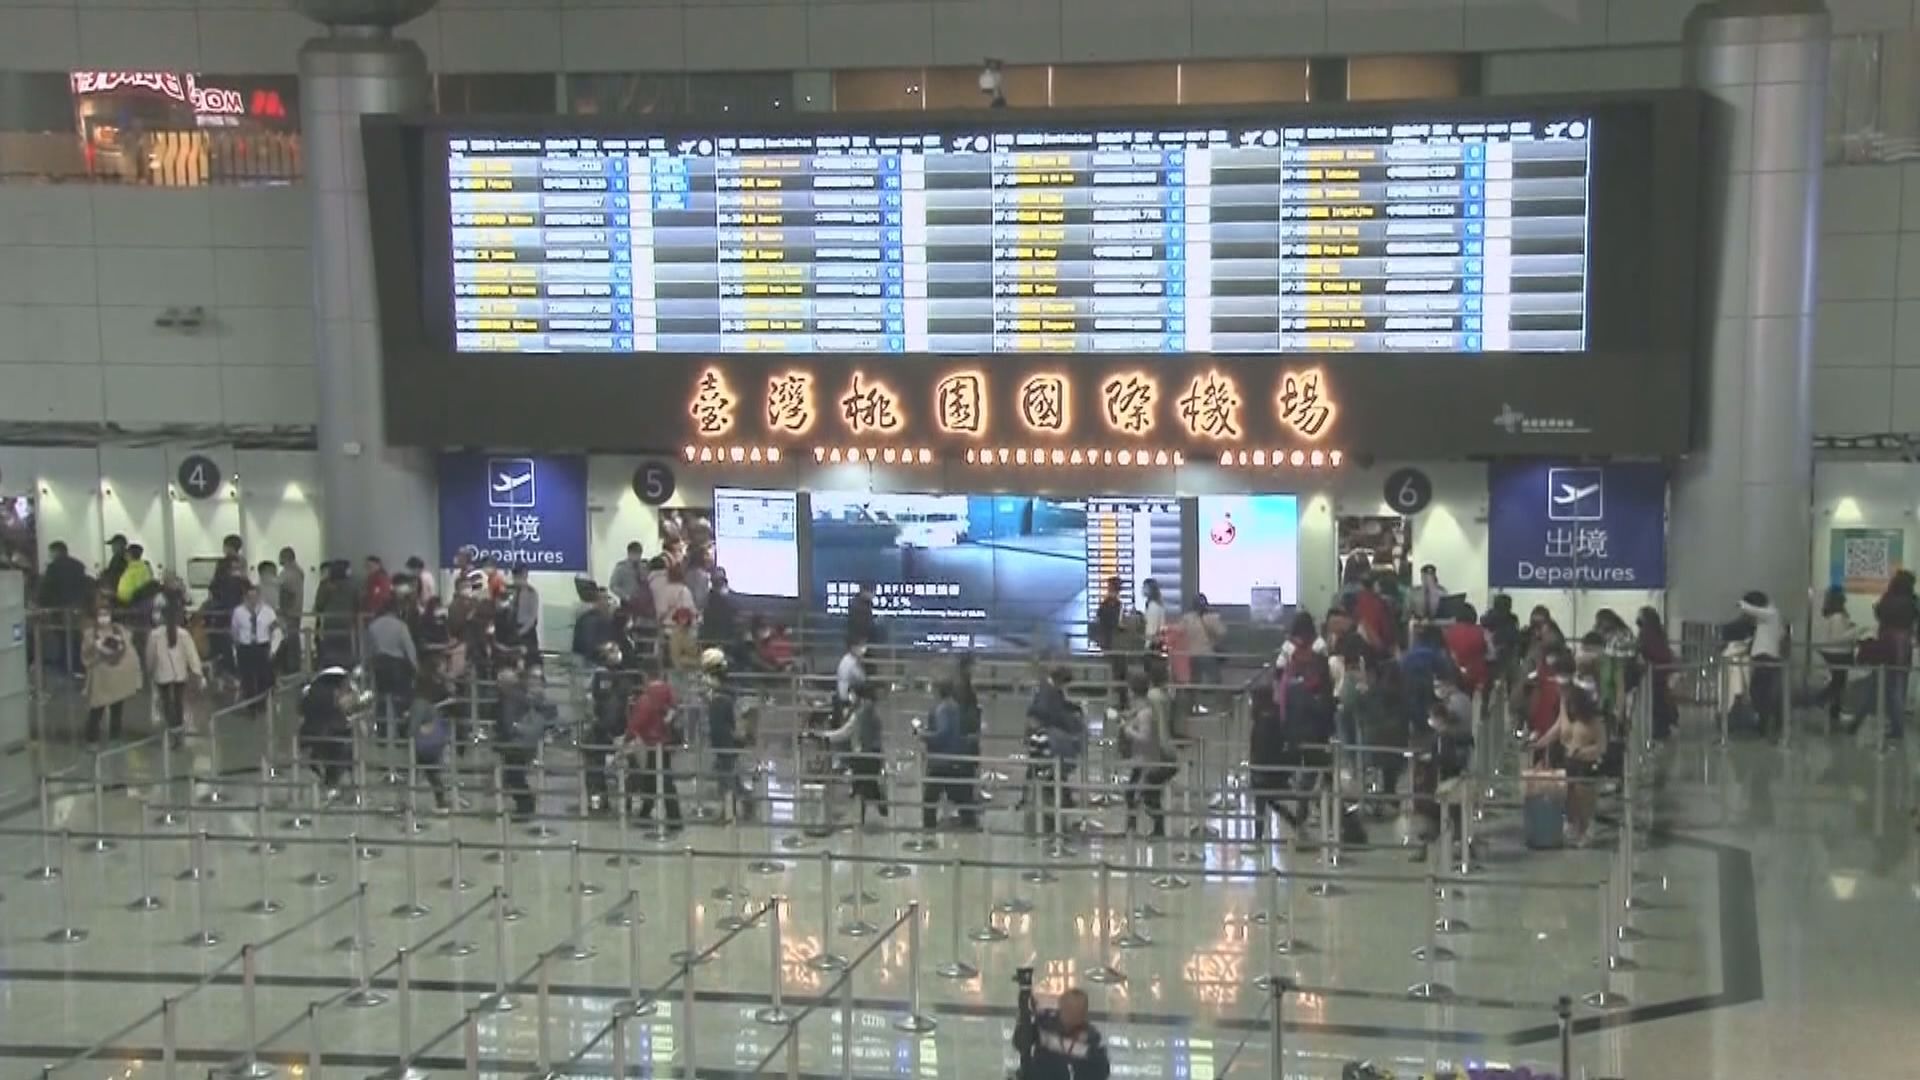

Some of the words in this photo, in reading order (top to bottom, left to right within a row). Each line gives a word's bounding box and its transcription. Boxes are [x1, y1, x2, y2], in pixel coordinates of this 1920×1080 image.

[690, 369, 1336, 439] 臺灣桃園國際機場
[684, 446, 781, 464] TAIWAN
[813, 447, 932, 465] TAOYUAN
[965, 448, 1185, 466] INTERNATIONAL
[1219, 449, 1343, 466] AIRPORT
[188, 464, 208, 491] 4
[646, 469, 664, 498] 5
[1399, 477, 1418, 507] 6
[487, 512, 541, 542] 出境
[1544, 527, 1608, 558] 出境
[1517, 561, 1636, 585] Departures
